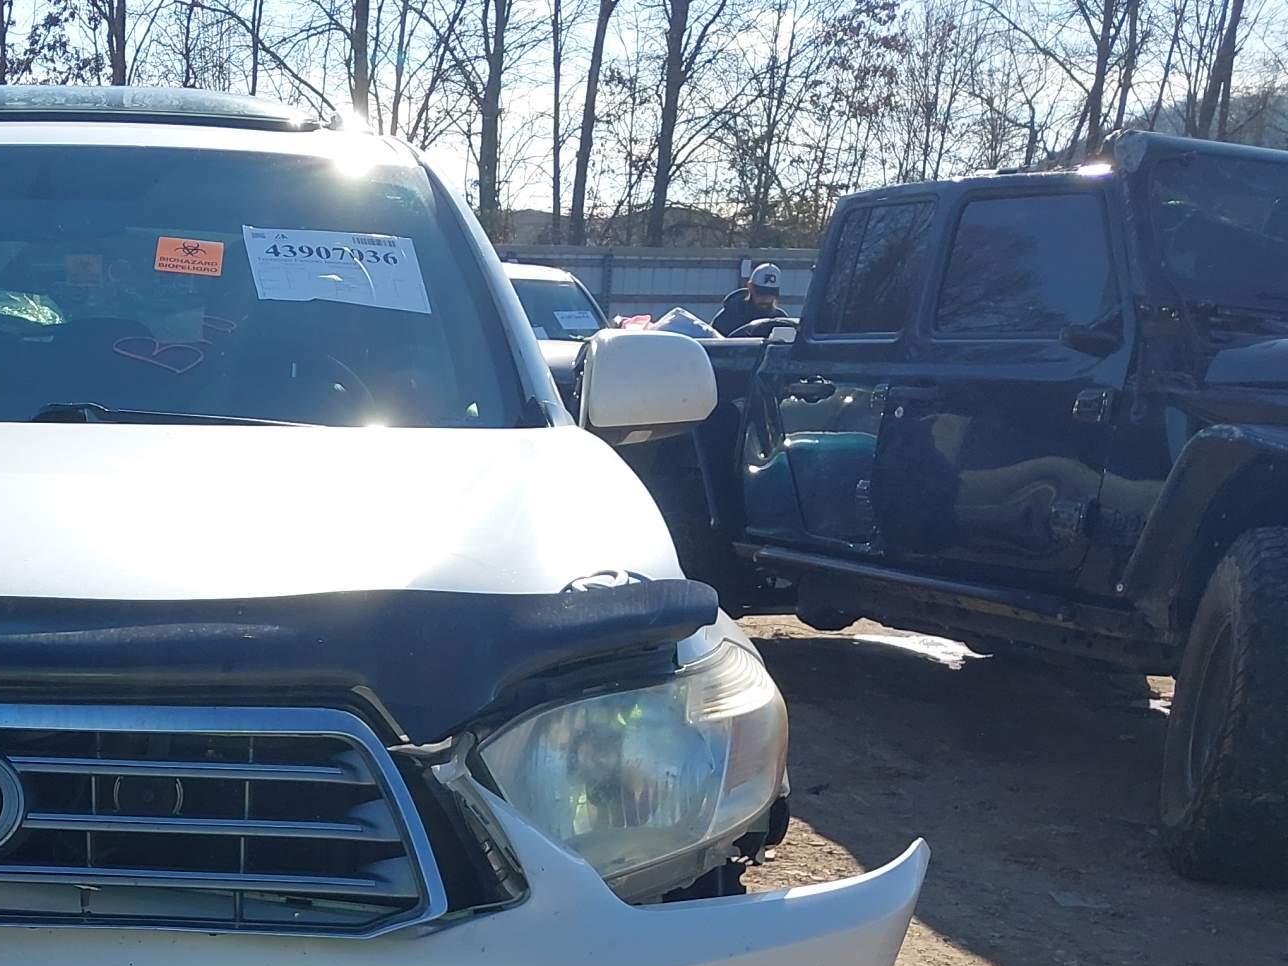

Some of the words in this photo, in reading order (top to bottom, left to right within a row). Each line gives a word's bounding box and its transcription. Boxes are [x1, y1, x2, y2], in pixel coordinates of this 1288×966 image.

[264, 243, 399, 265] 43907036
[159, 256, 218, 267] BIOHAZARD
[158, 262, 218, 273] BIOPELIGRO
